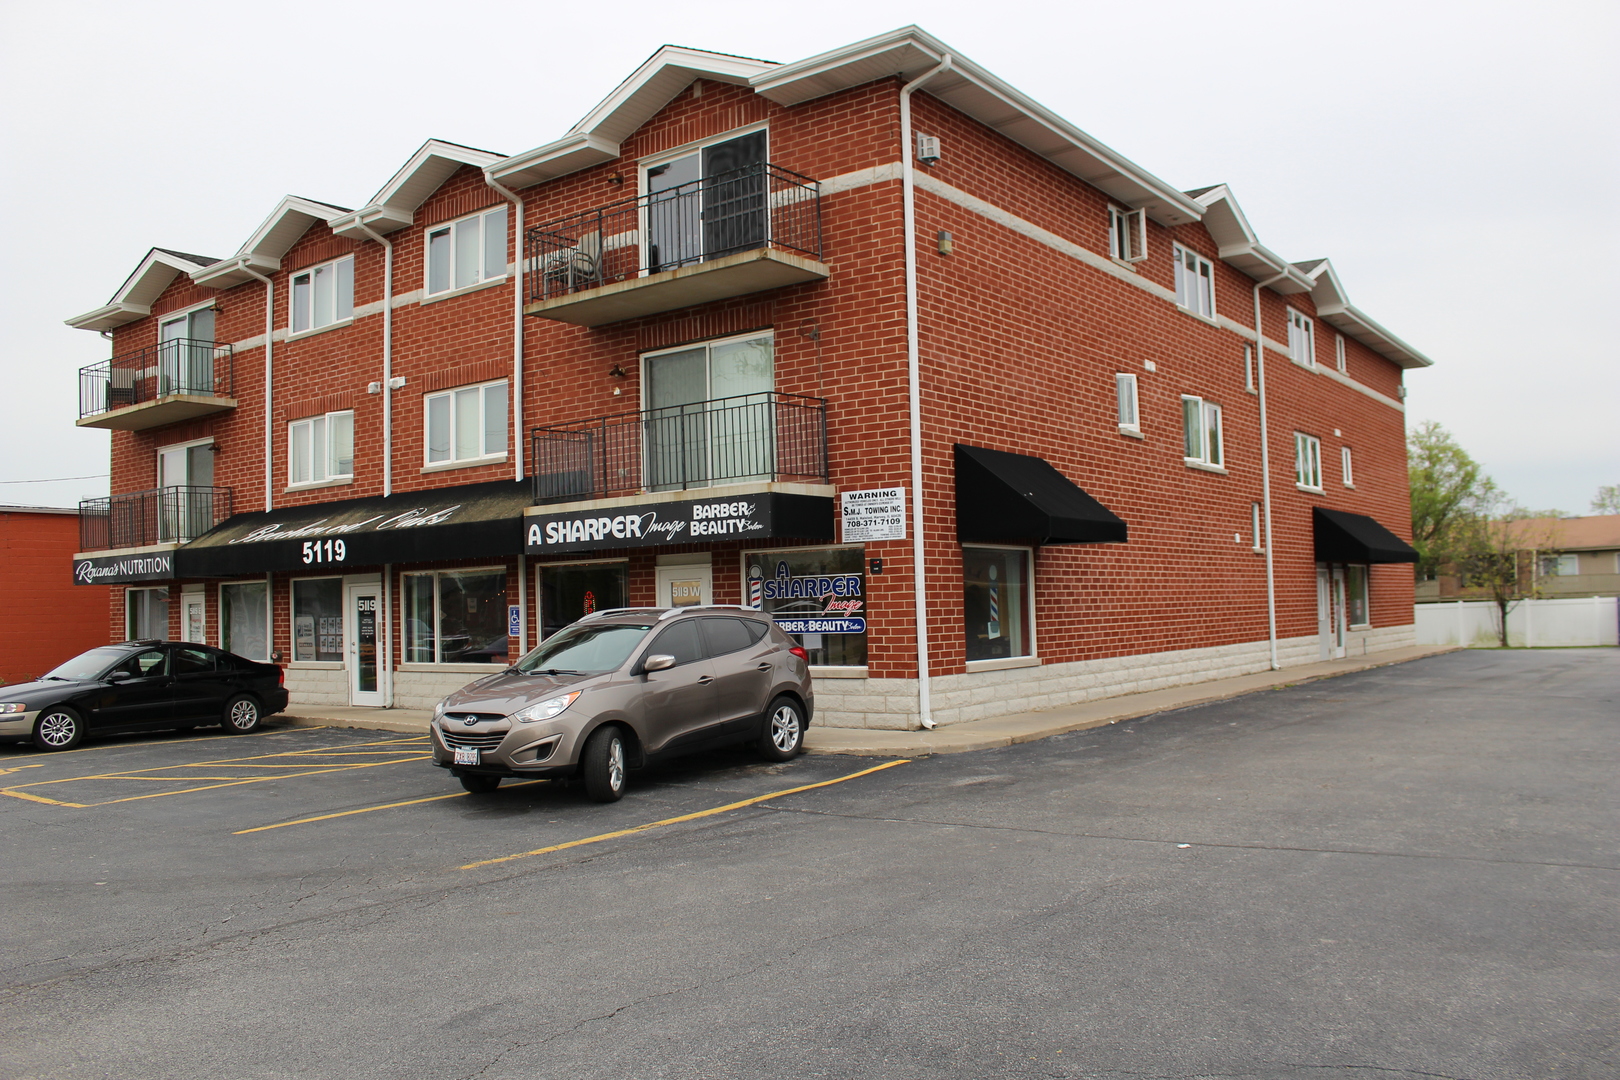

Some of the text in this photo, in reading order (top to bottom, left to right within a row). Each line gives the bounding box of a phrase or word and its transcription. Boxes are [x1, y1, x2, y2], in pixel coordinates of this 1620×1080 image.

[849, 490, 897, 500] WARNING
[693, 501, 748, 520] BARBER
[843, 505, 902, 516] S.M.J. TOWING INC.
[528, 511, 687, 546] A SHARPER Image
[690, 518, 745, 536] BEAUTY
[847, 518, 900, 527] 708-371-7109
[302, 539, 346, 564] 5119
[76, 557, 170, 583] Roxana's NUTRITION
[775, 560, 790, 579] A
[672, 586, 700, 597] 5119 W
[763, 576, 861, 599] SHARPER
[358, 600, 376, 611] 5119
[819, 592, 863, 617] Image
[775, 621, 805, 632] RBER
[808, 620, 848, 632] BEAUTY
